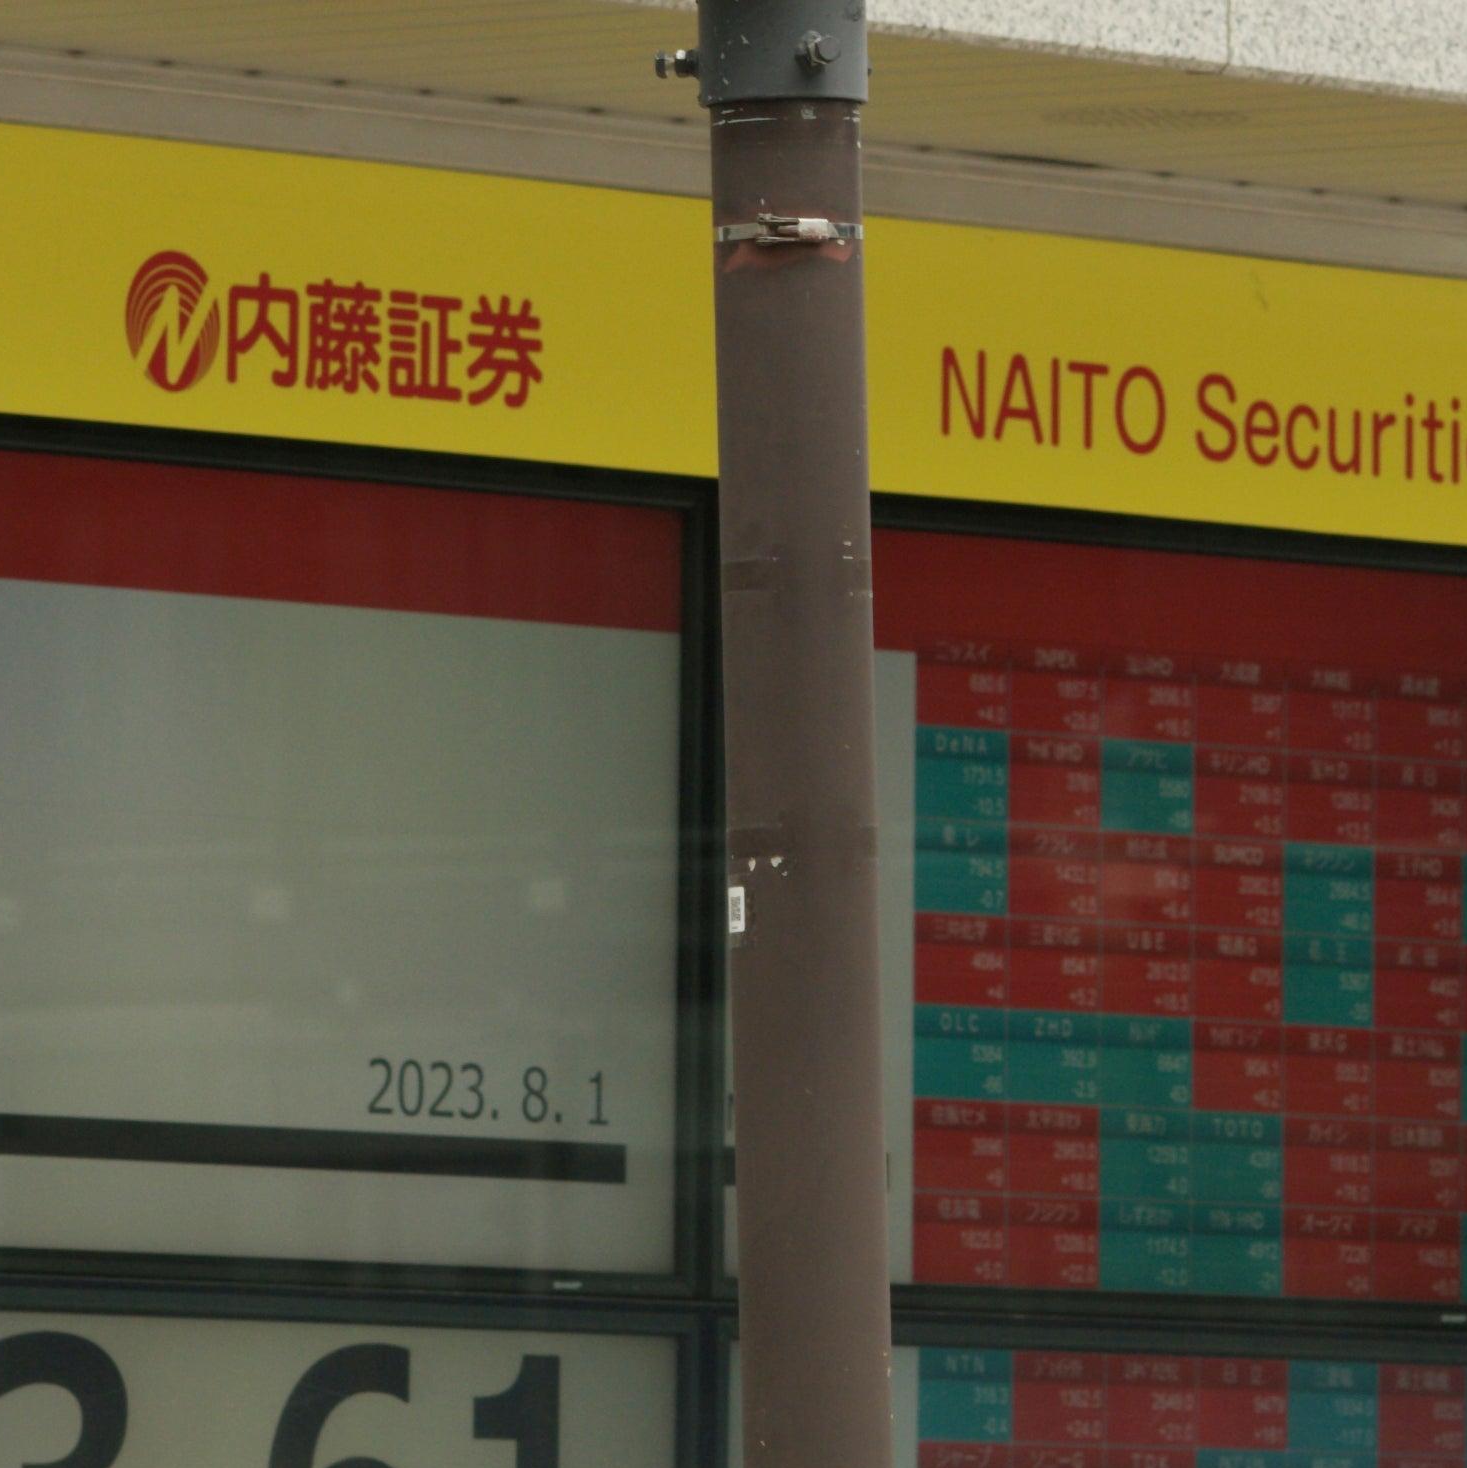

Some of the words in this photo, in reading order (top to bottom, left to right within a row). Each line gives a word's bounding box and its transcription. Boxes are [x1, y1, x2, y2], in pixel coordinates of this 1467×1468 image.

[226, 271, 544, 409] 内藤証券
[940, 345, 1167, 455] NAITO
[935, 733, 988, 753] DeNA
[1126, 931, 1166, 950] UBE
[939, 1013, 980, 1032] OLC
[1034, 1017, 1074, 1036] ZHD
[1213, 1119, 1264, 1137] TOTO
[945, 1355, 985, 1374] NTN
